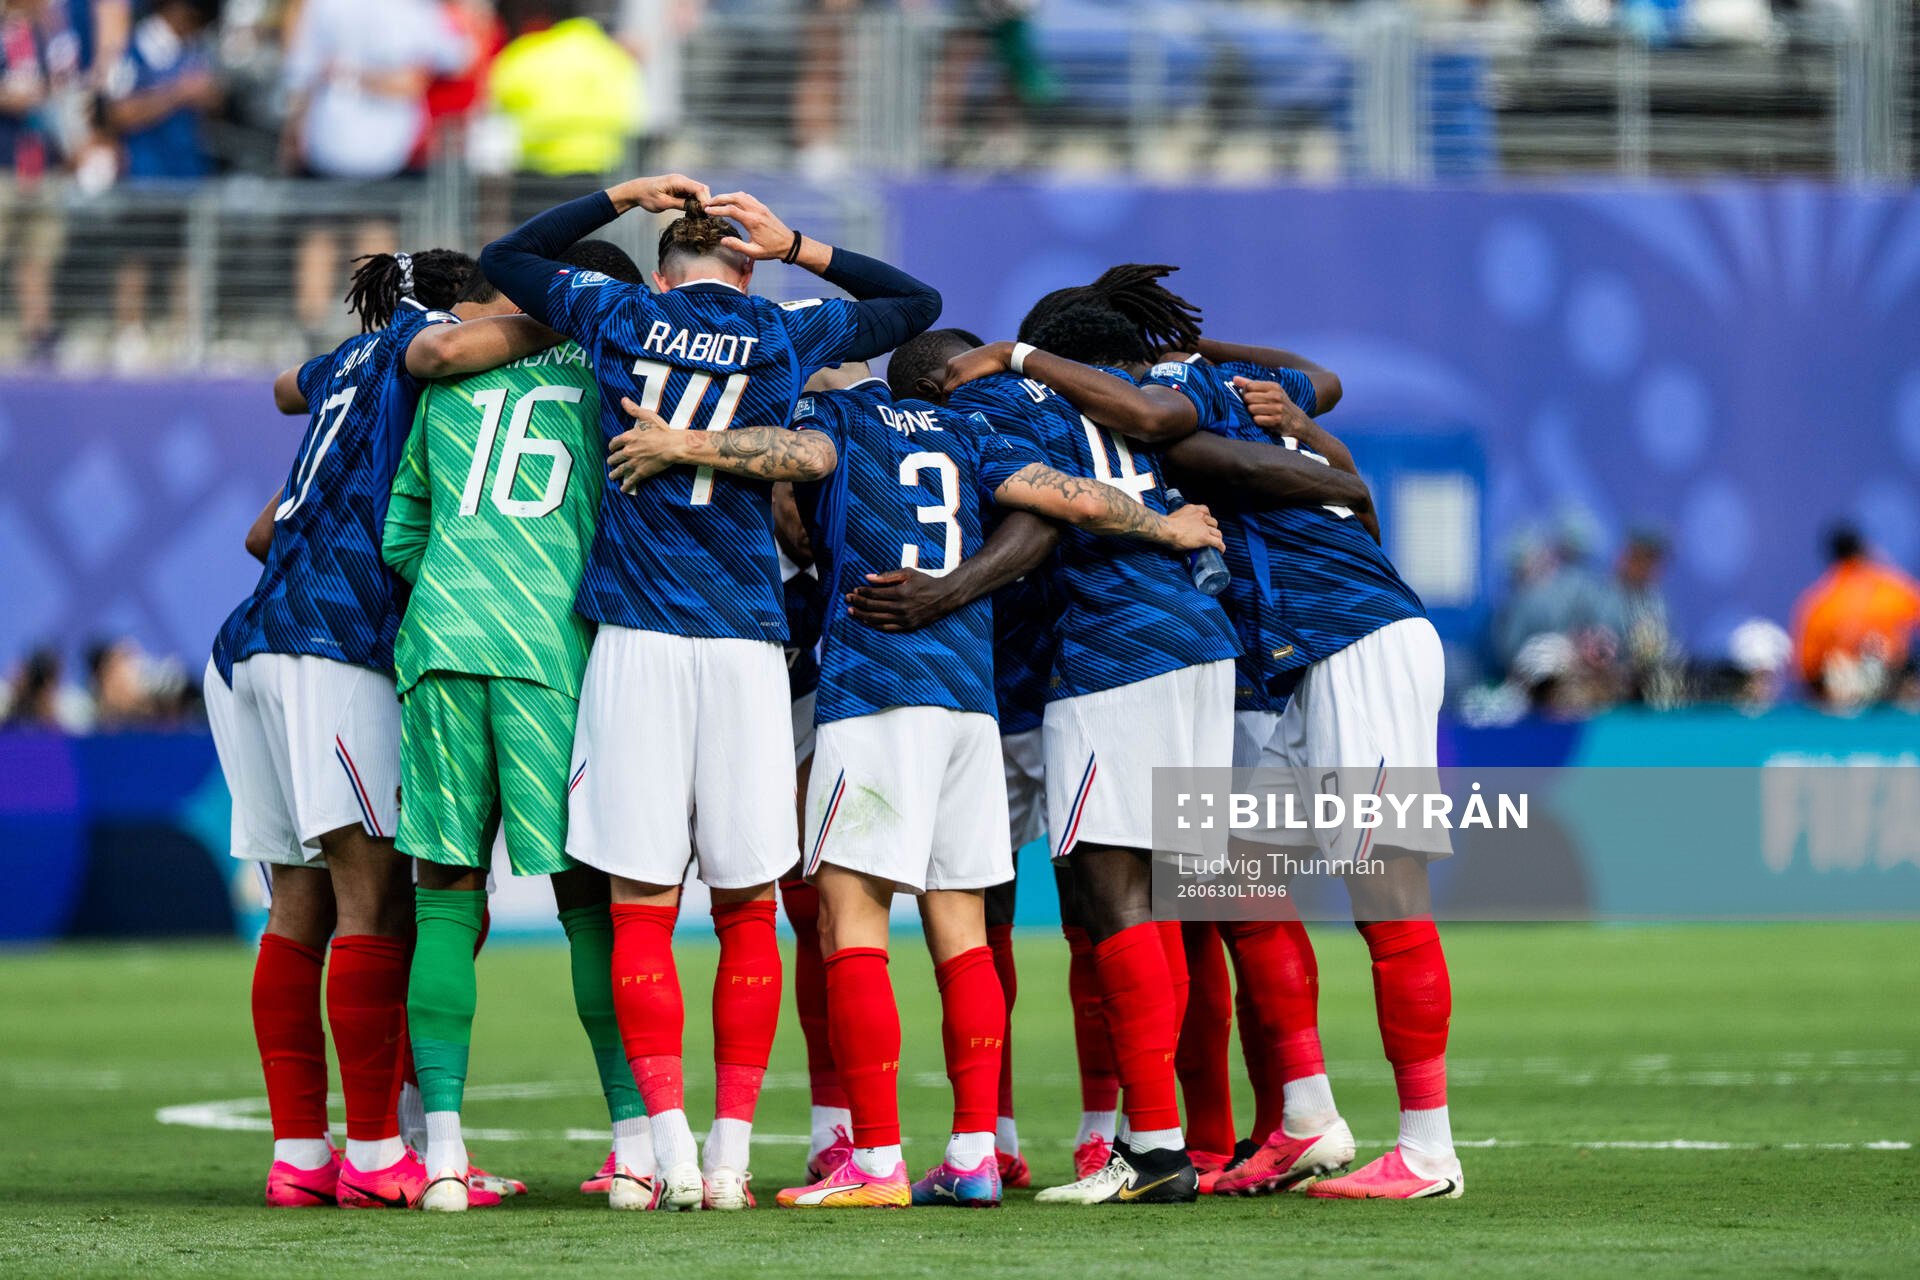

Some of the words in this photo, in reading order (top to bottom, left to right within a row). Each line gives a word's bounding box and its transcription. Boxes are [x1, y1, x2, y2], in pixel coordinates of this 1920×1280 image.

[643, 320, 759, 366] RABIOT
[458, 385, 586, 518] 16
[1080, 414, 1156, 506] 4
[899, 451, 962, 579] 3
[621, 973, 664, 987] FFF
[731, 975, 773, 986] FFF
